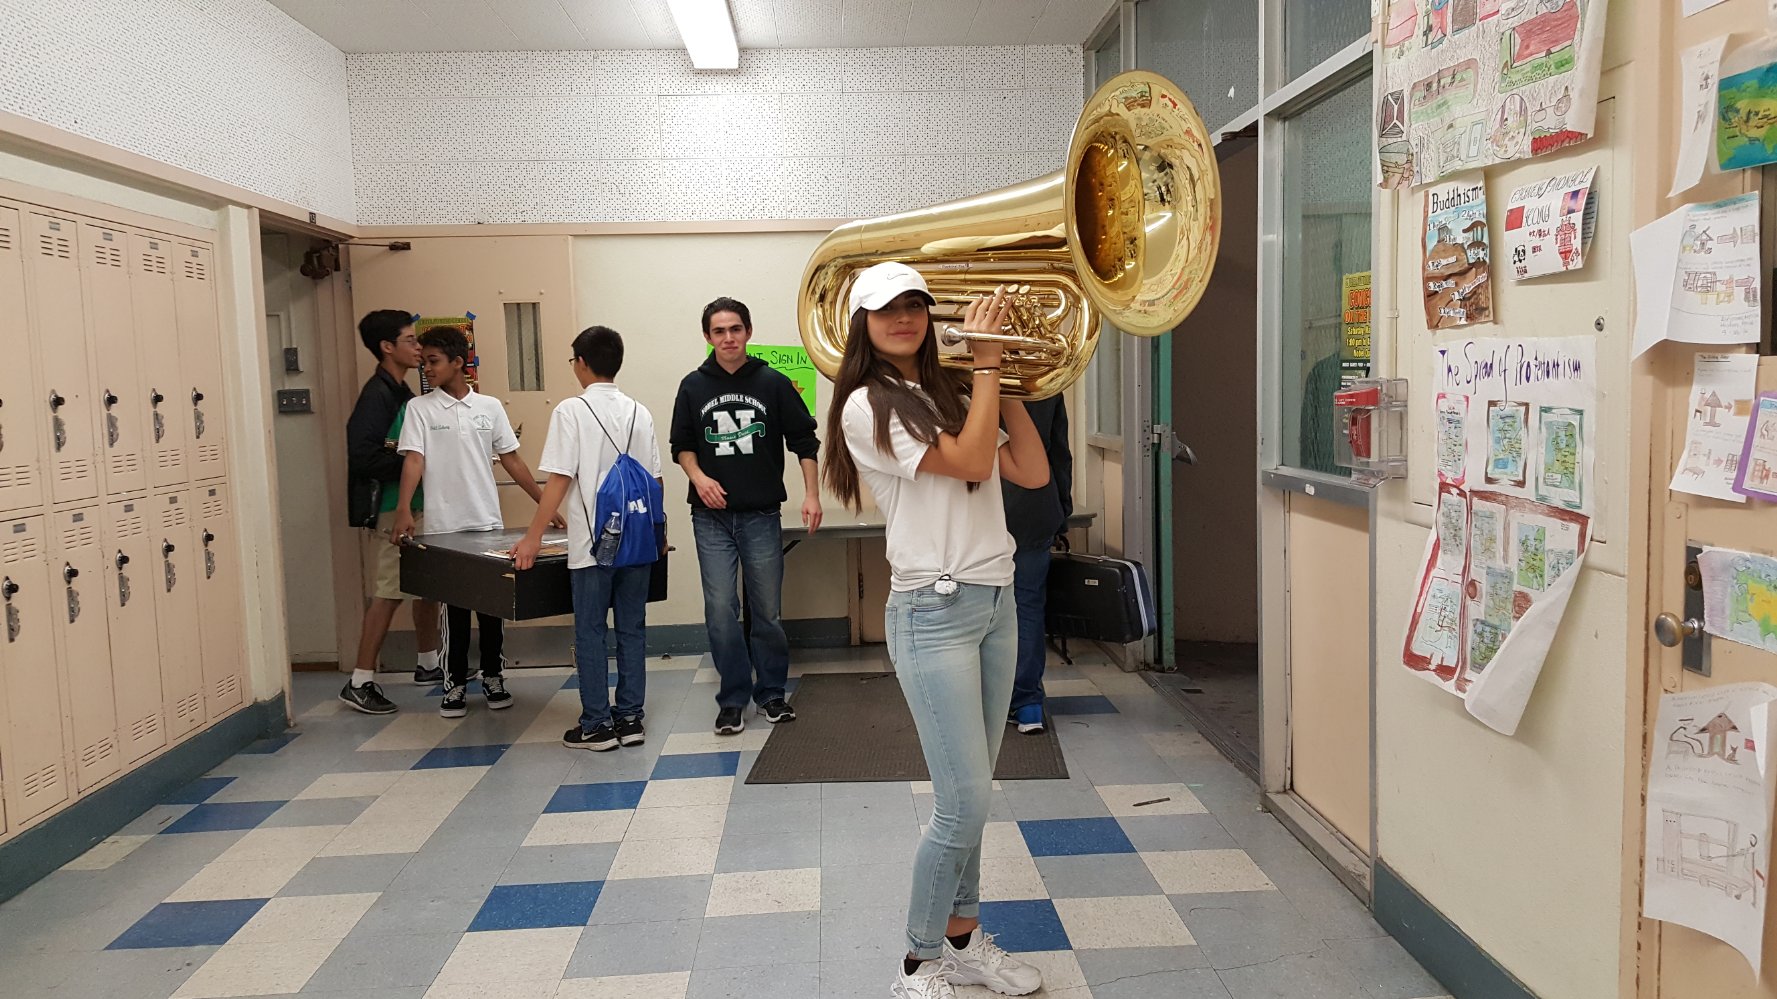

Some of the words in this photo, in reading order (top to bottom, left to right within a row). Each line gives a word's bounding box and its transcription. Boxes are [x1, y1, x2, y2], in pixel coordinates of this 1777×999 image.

[1438, 349, 1461, 391] The
[1463, 341, 1496, 395] Spread
[720, 394, 744, 404] MIDDLE
[745, 395, 767, 415] SCHOOL
